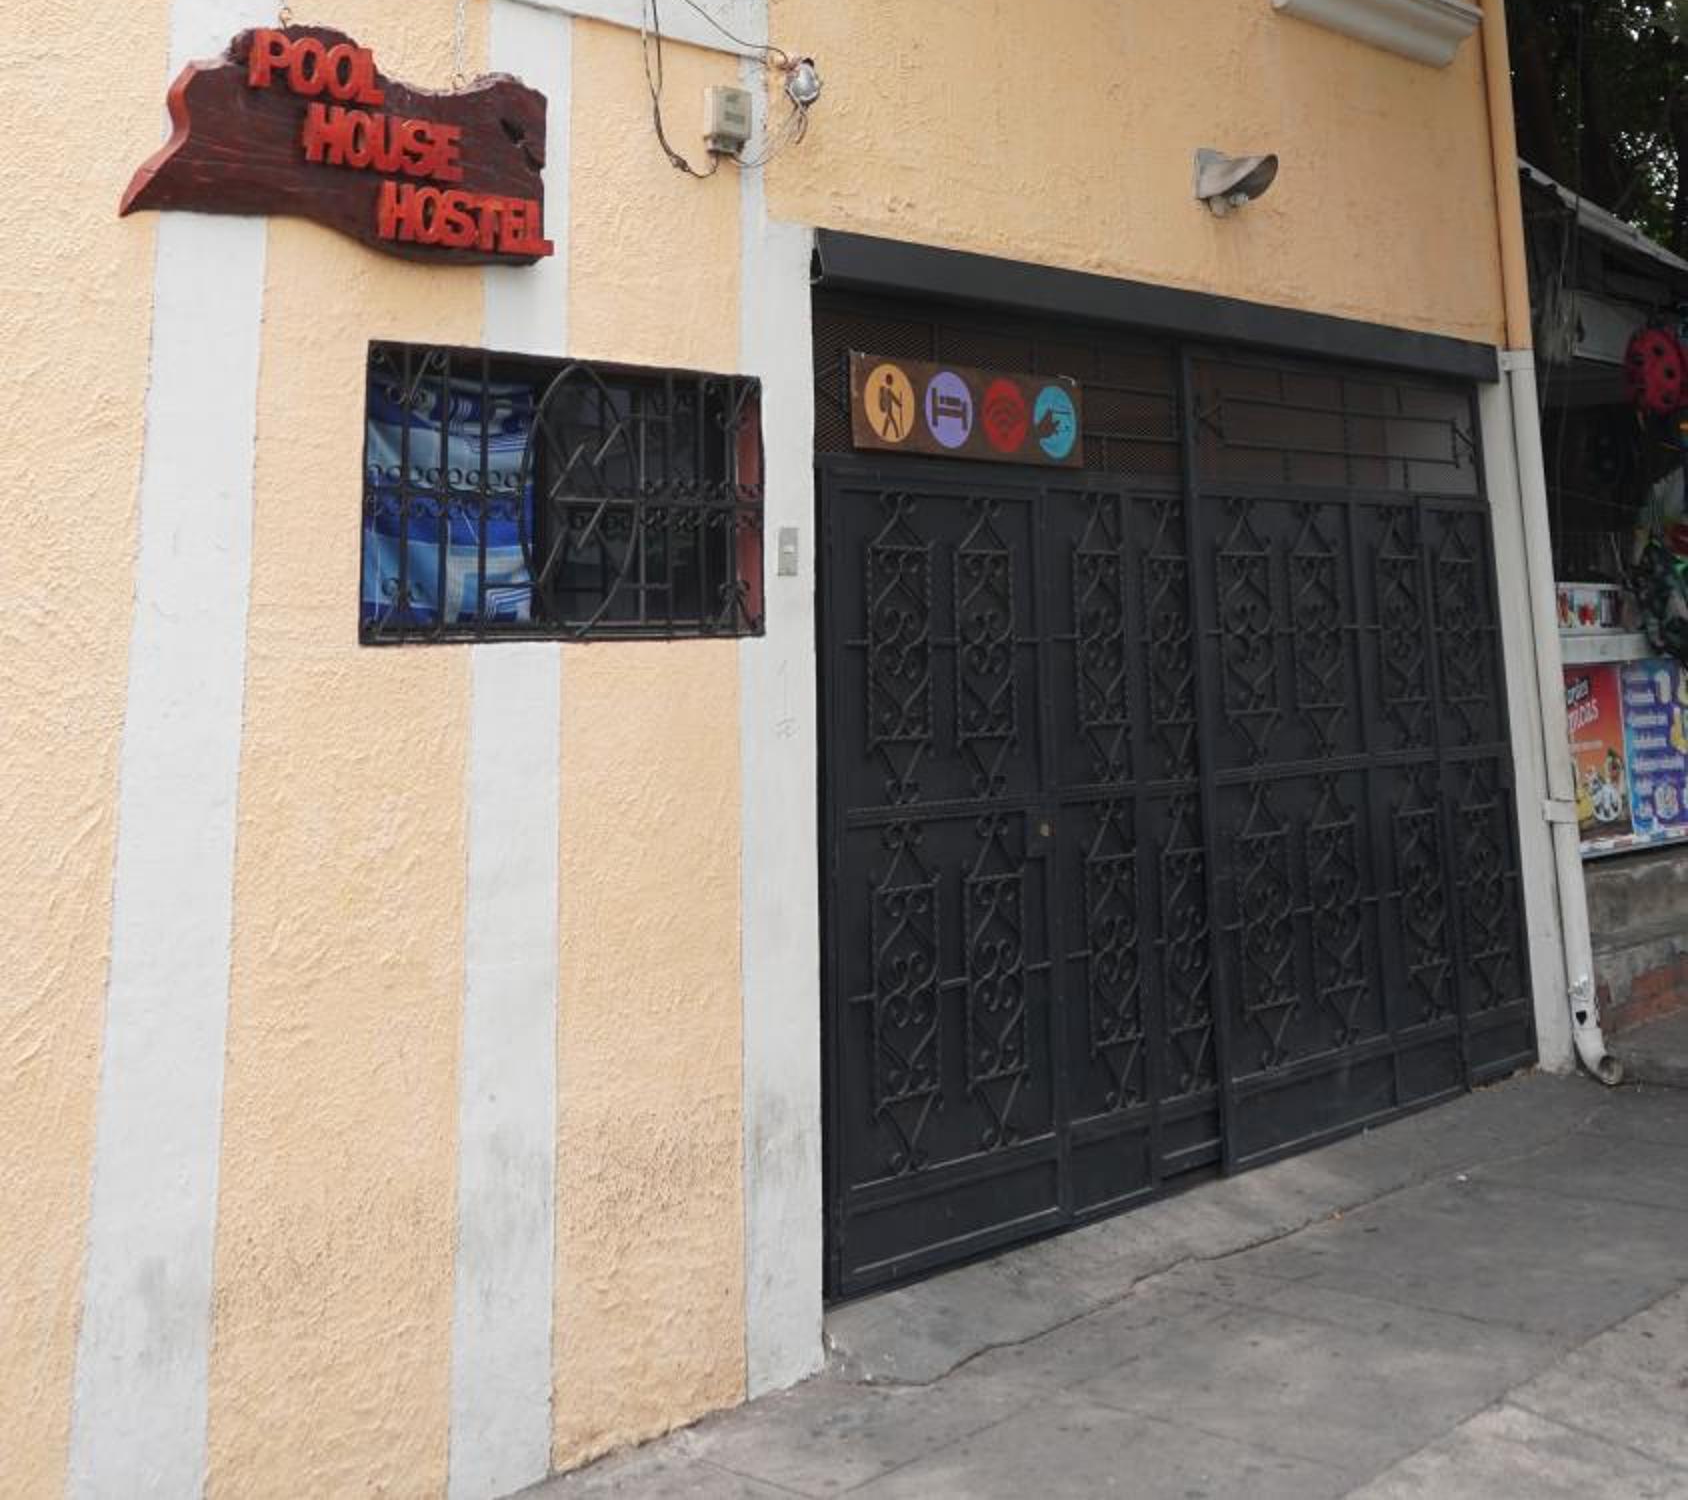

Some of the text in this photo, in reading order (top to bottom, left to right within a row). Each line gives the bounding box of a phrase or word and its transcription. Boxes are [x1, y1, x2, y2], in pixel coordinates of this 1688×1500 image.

[248, 28, 385, 105] POOL
[303, 100, 464, 182] HOUSE
[377, 179, 554, 257] HOSTEL
